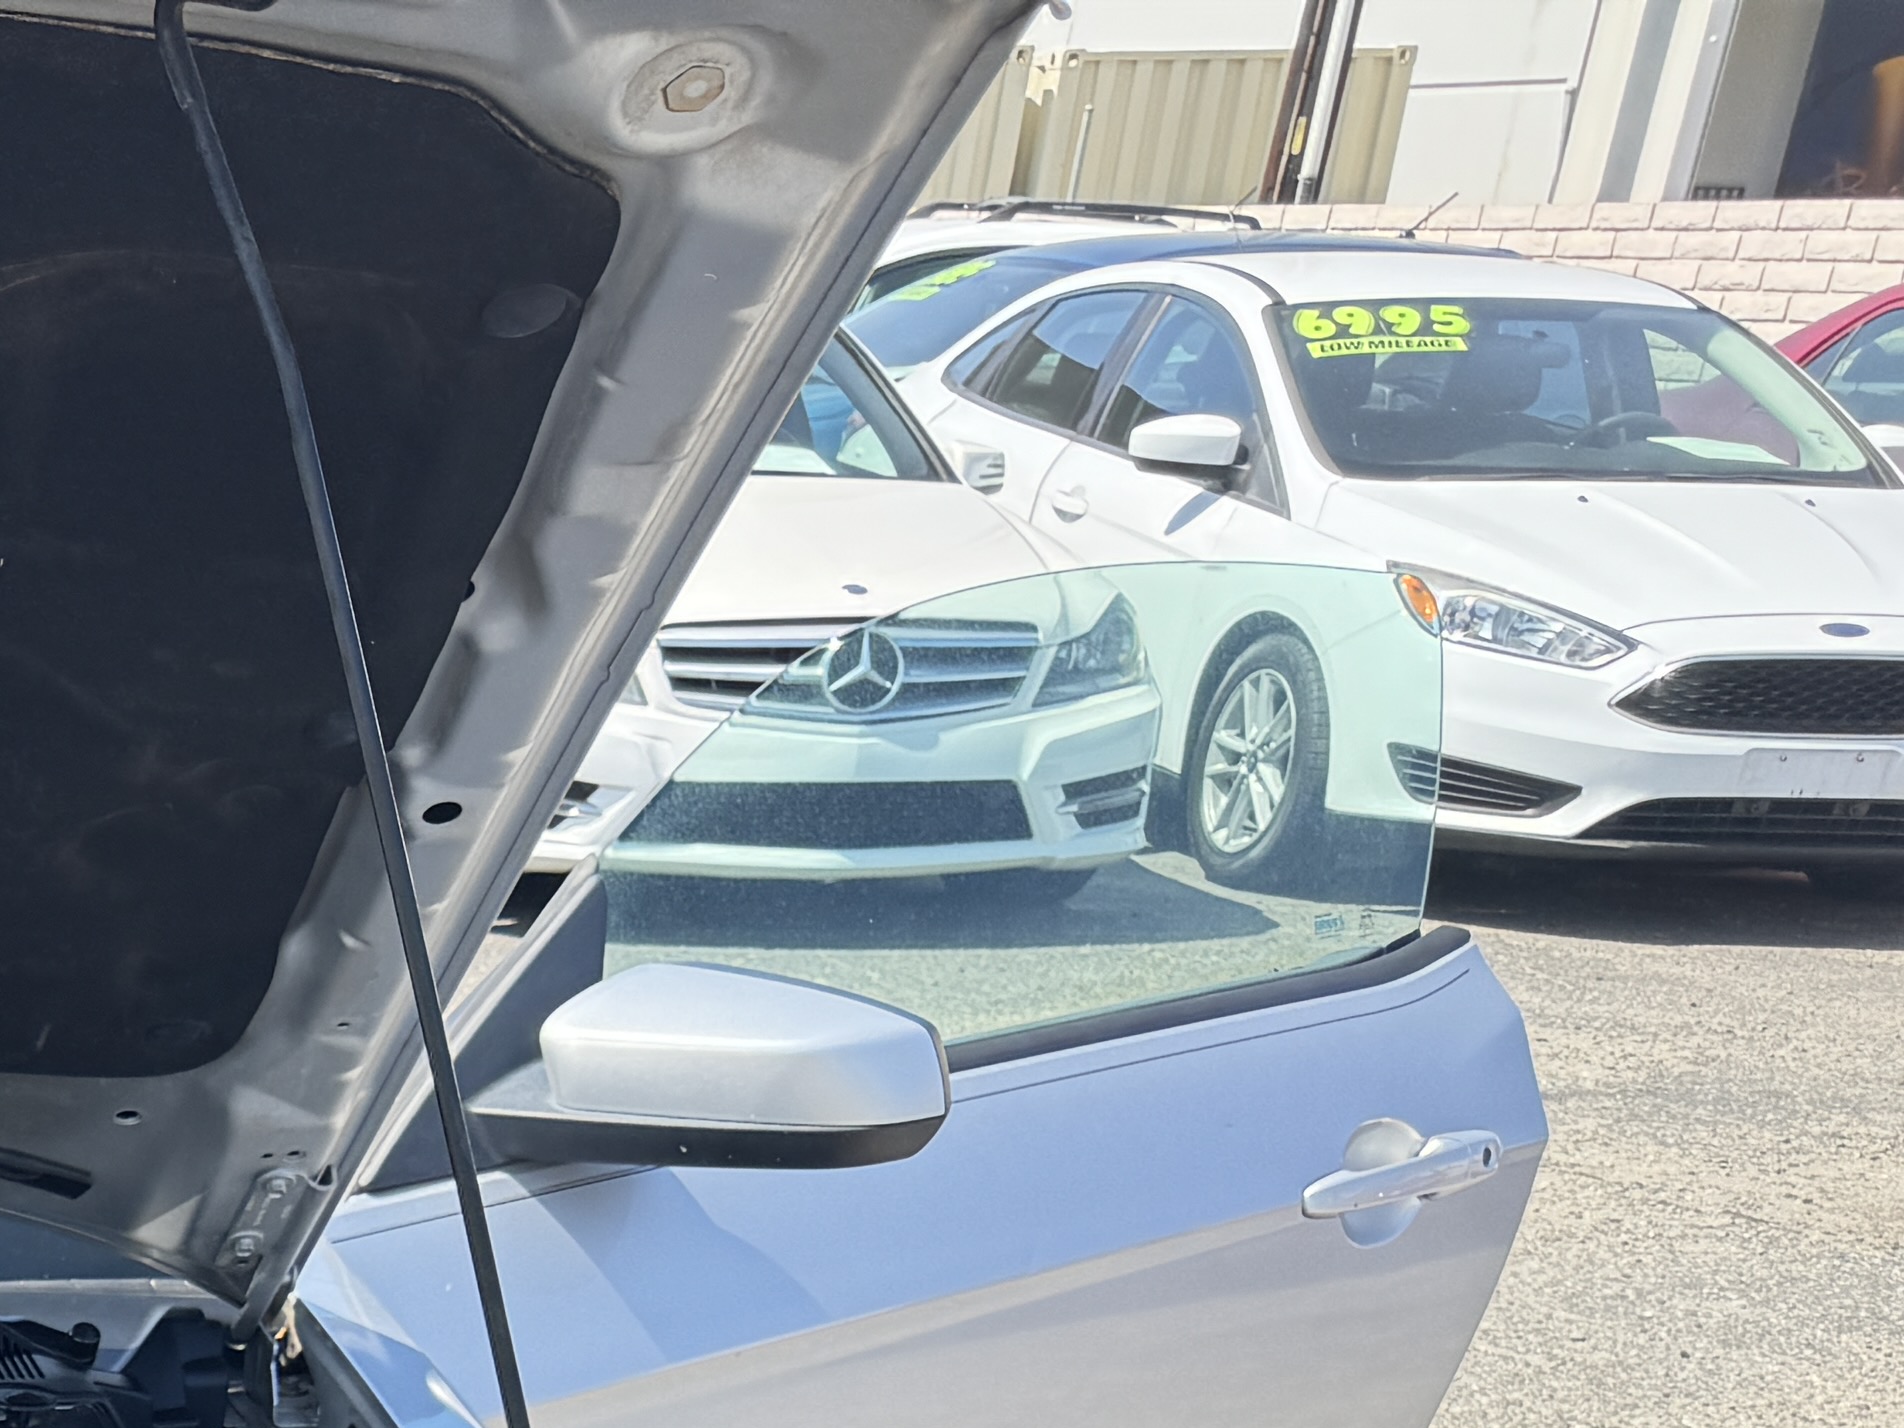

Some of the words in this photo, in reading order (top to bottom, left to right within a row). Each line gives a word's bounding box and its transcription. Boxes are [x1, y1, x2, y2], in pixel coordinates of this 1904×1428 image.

[1293, 305, 1471, 340] 6995
[1319, 341, 1363, 353] LOW
[1367, 338, 1457, 350] MILEAGE
